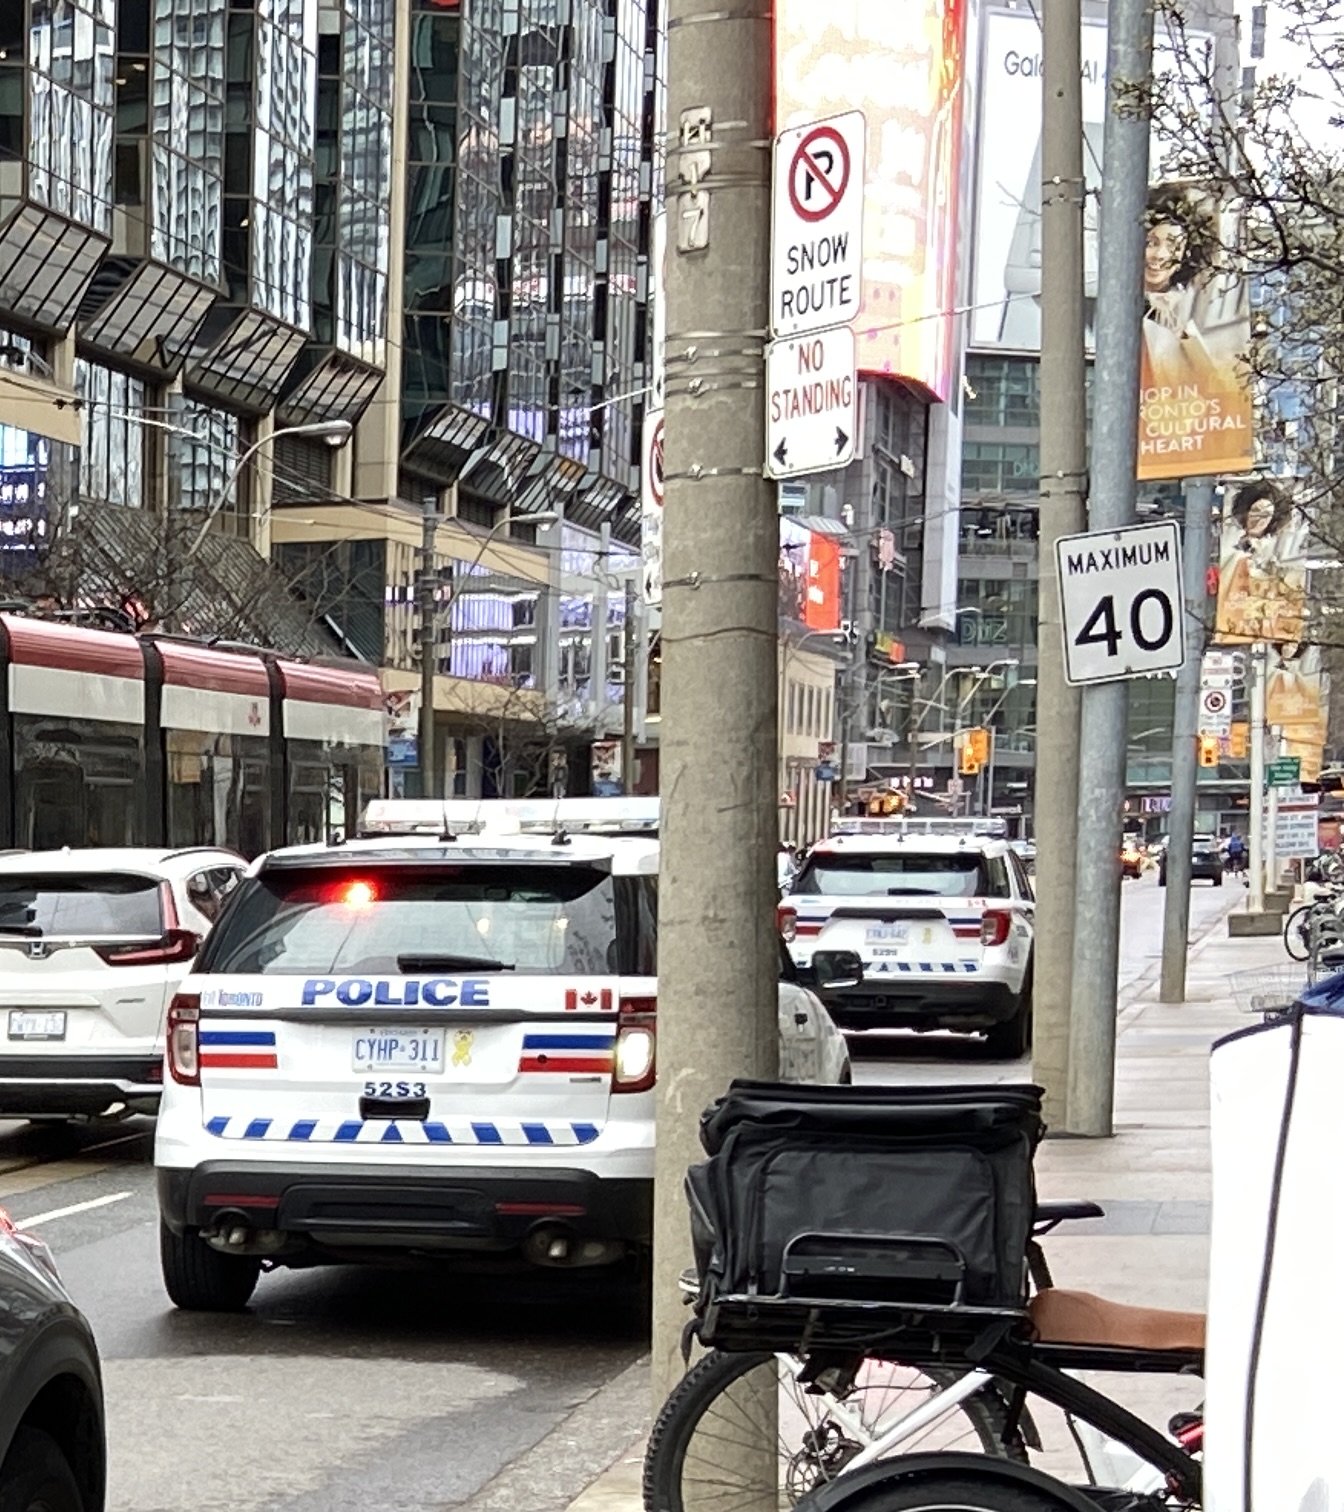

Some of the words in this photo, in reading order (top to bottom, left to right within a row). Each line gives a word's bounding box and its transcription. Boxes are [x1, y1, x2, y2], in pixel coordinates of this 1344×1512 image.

[786, 231, 849, 275] SNOW
[780, 275, 852, 319] ROUTE
[797, 339, 825, 375] NO
[771, 374, 852, 424] STANDING
[1178, 384, 1198, 400] IN
[1145, 413, 1247, 438] CULTURAL
[1141, 434, 1204, 455] HEART
[1068, 540, 1169, 577] MAXIMUM
[1074, 586, 1174, 657] 40
[301, 979, 491, 1007] POLICE
[355, 1038, 399, 1061] CYHP
[408, 1038, 440, 1062] 311
